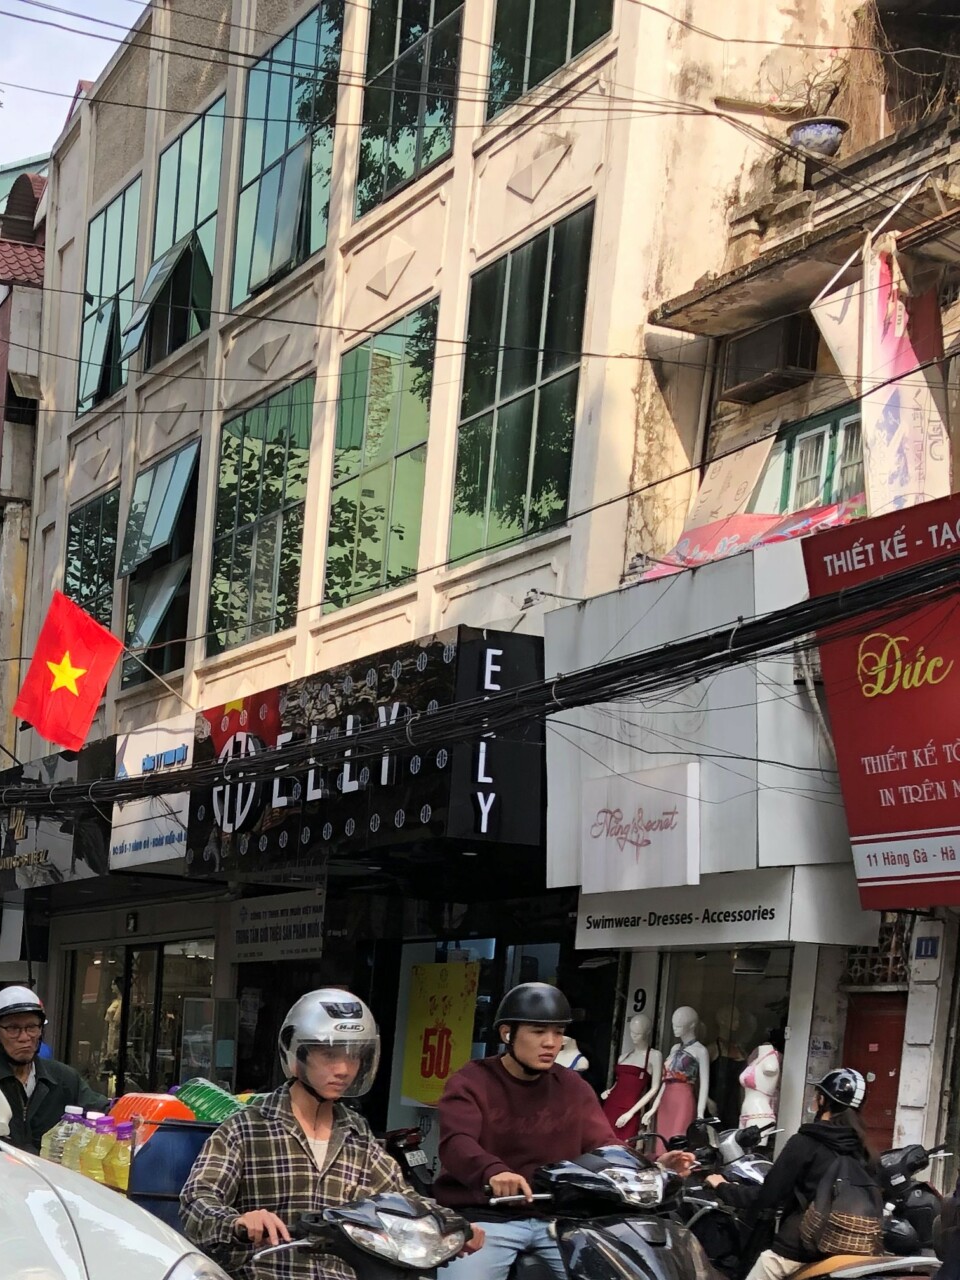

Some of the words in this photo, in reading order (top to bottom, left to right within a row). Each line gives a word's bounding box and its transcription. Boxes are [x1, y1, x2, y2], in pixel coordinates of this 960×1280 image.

[823, 538, 874, 577] THIẾT
[881, 525, 908, 562] KẾ
[861, 745, 908, 775] THIẾT
[912, 739, 938, 768] KẾ
[879, 787, 896, 807] IN
[898, 779, 947, 804] TRÊN
[866, 854, 878, 867] 11
[882, 850, 910, 867] Hàng
[913, 848, 928, 863] Gà
[941, 846, 957, 861] Hà
[586, 915, 641, 930] Swimwear
[648, 911, 693, 927] Dresses
[702, 905, 775, 924] Accessories
[920, 940, 932, 956] 11
[633, 988, 647, 1012] 9
[421, 1027, 452, 1079] 50
